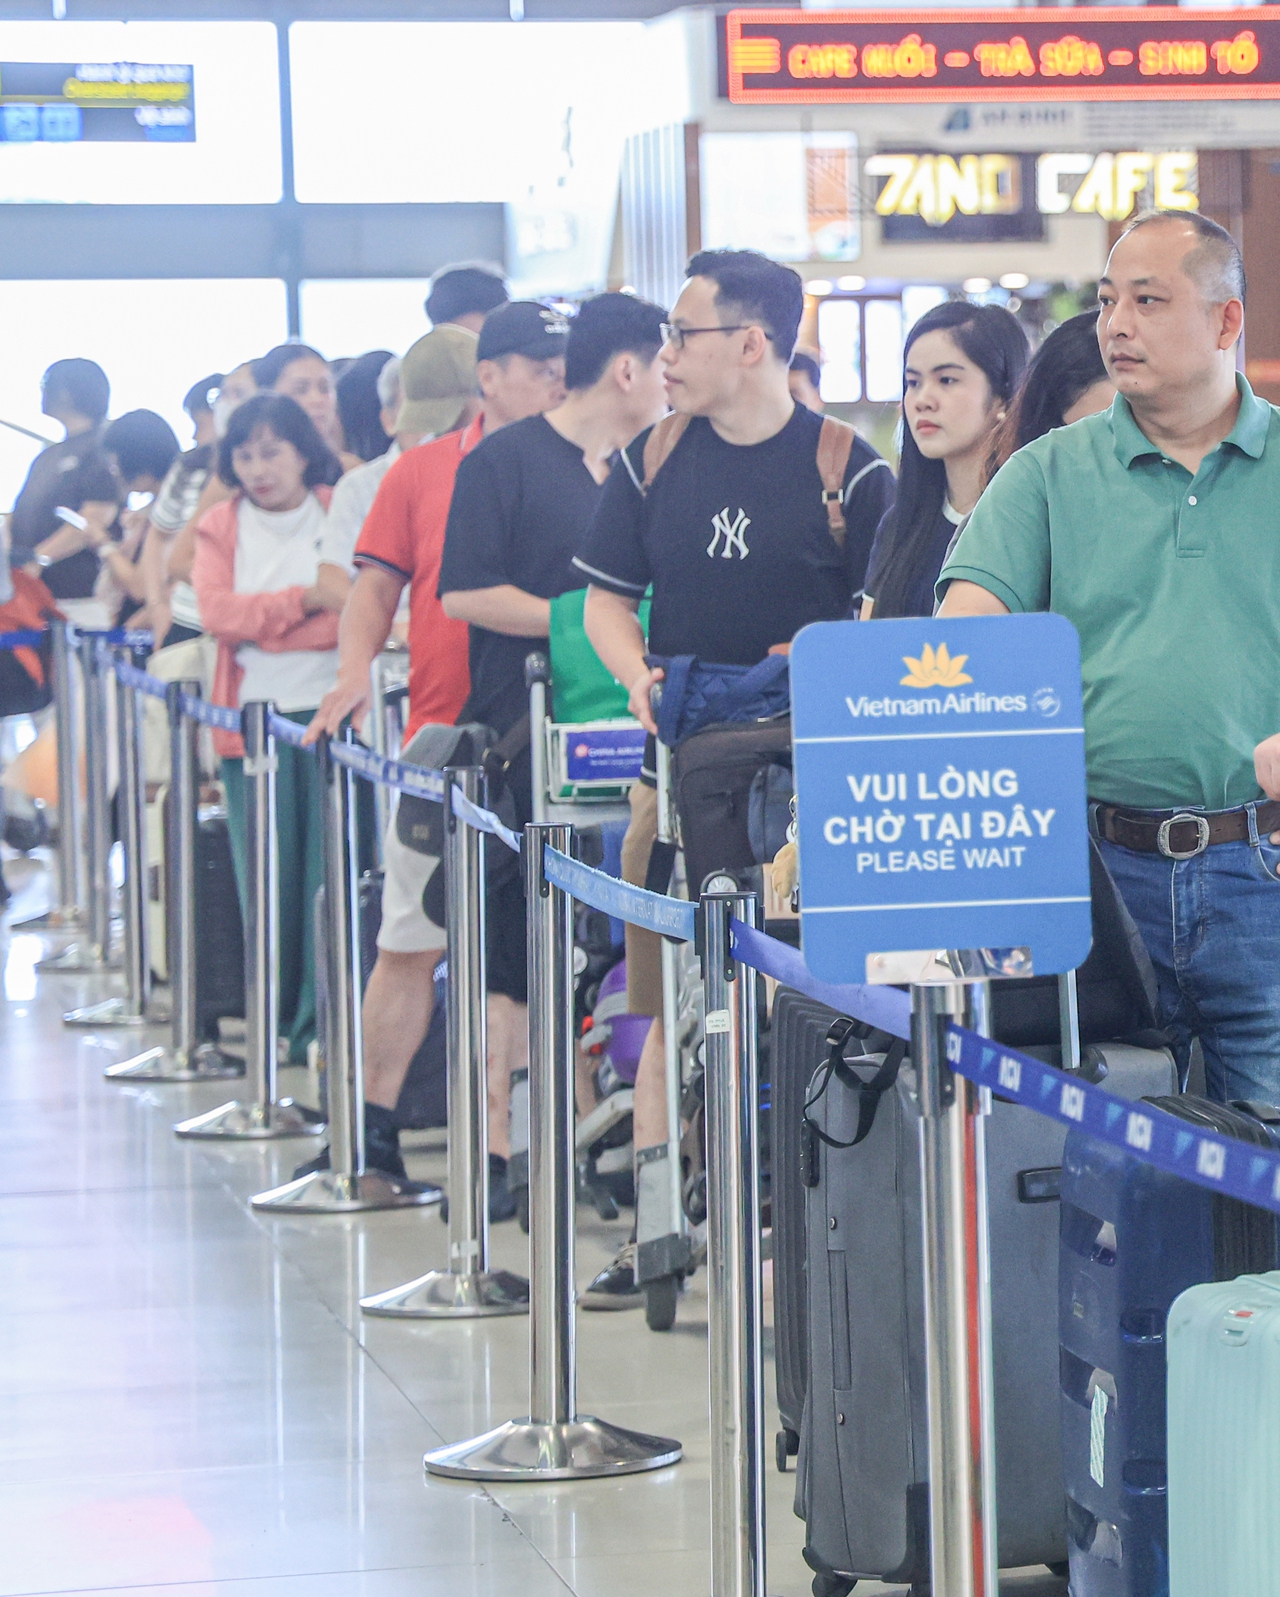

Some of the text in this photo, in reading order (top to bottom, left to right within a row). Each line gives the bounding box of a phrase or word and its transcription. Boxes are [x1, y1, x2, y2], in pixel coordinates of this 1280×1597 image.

[1037, 151, 1198, 221] CAFE
[847, 765, 1018, 803] VUI LÒNG
[823, 804, 1056, 847] CHỜ TẠI ĐÂY
[857, 846, 1026, 874] PLEASE WAIT
